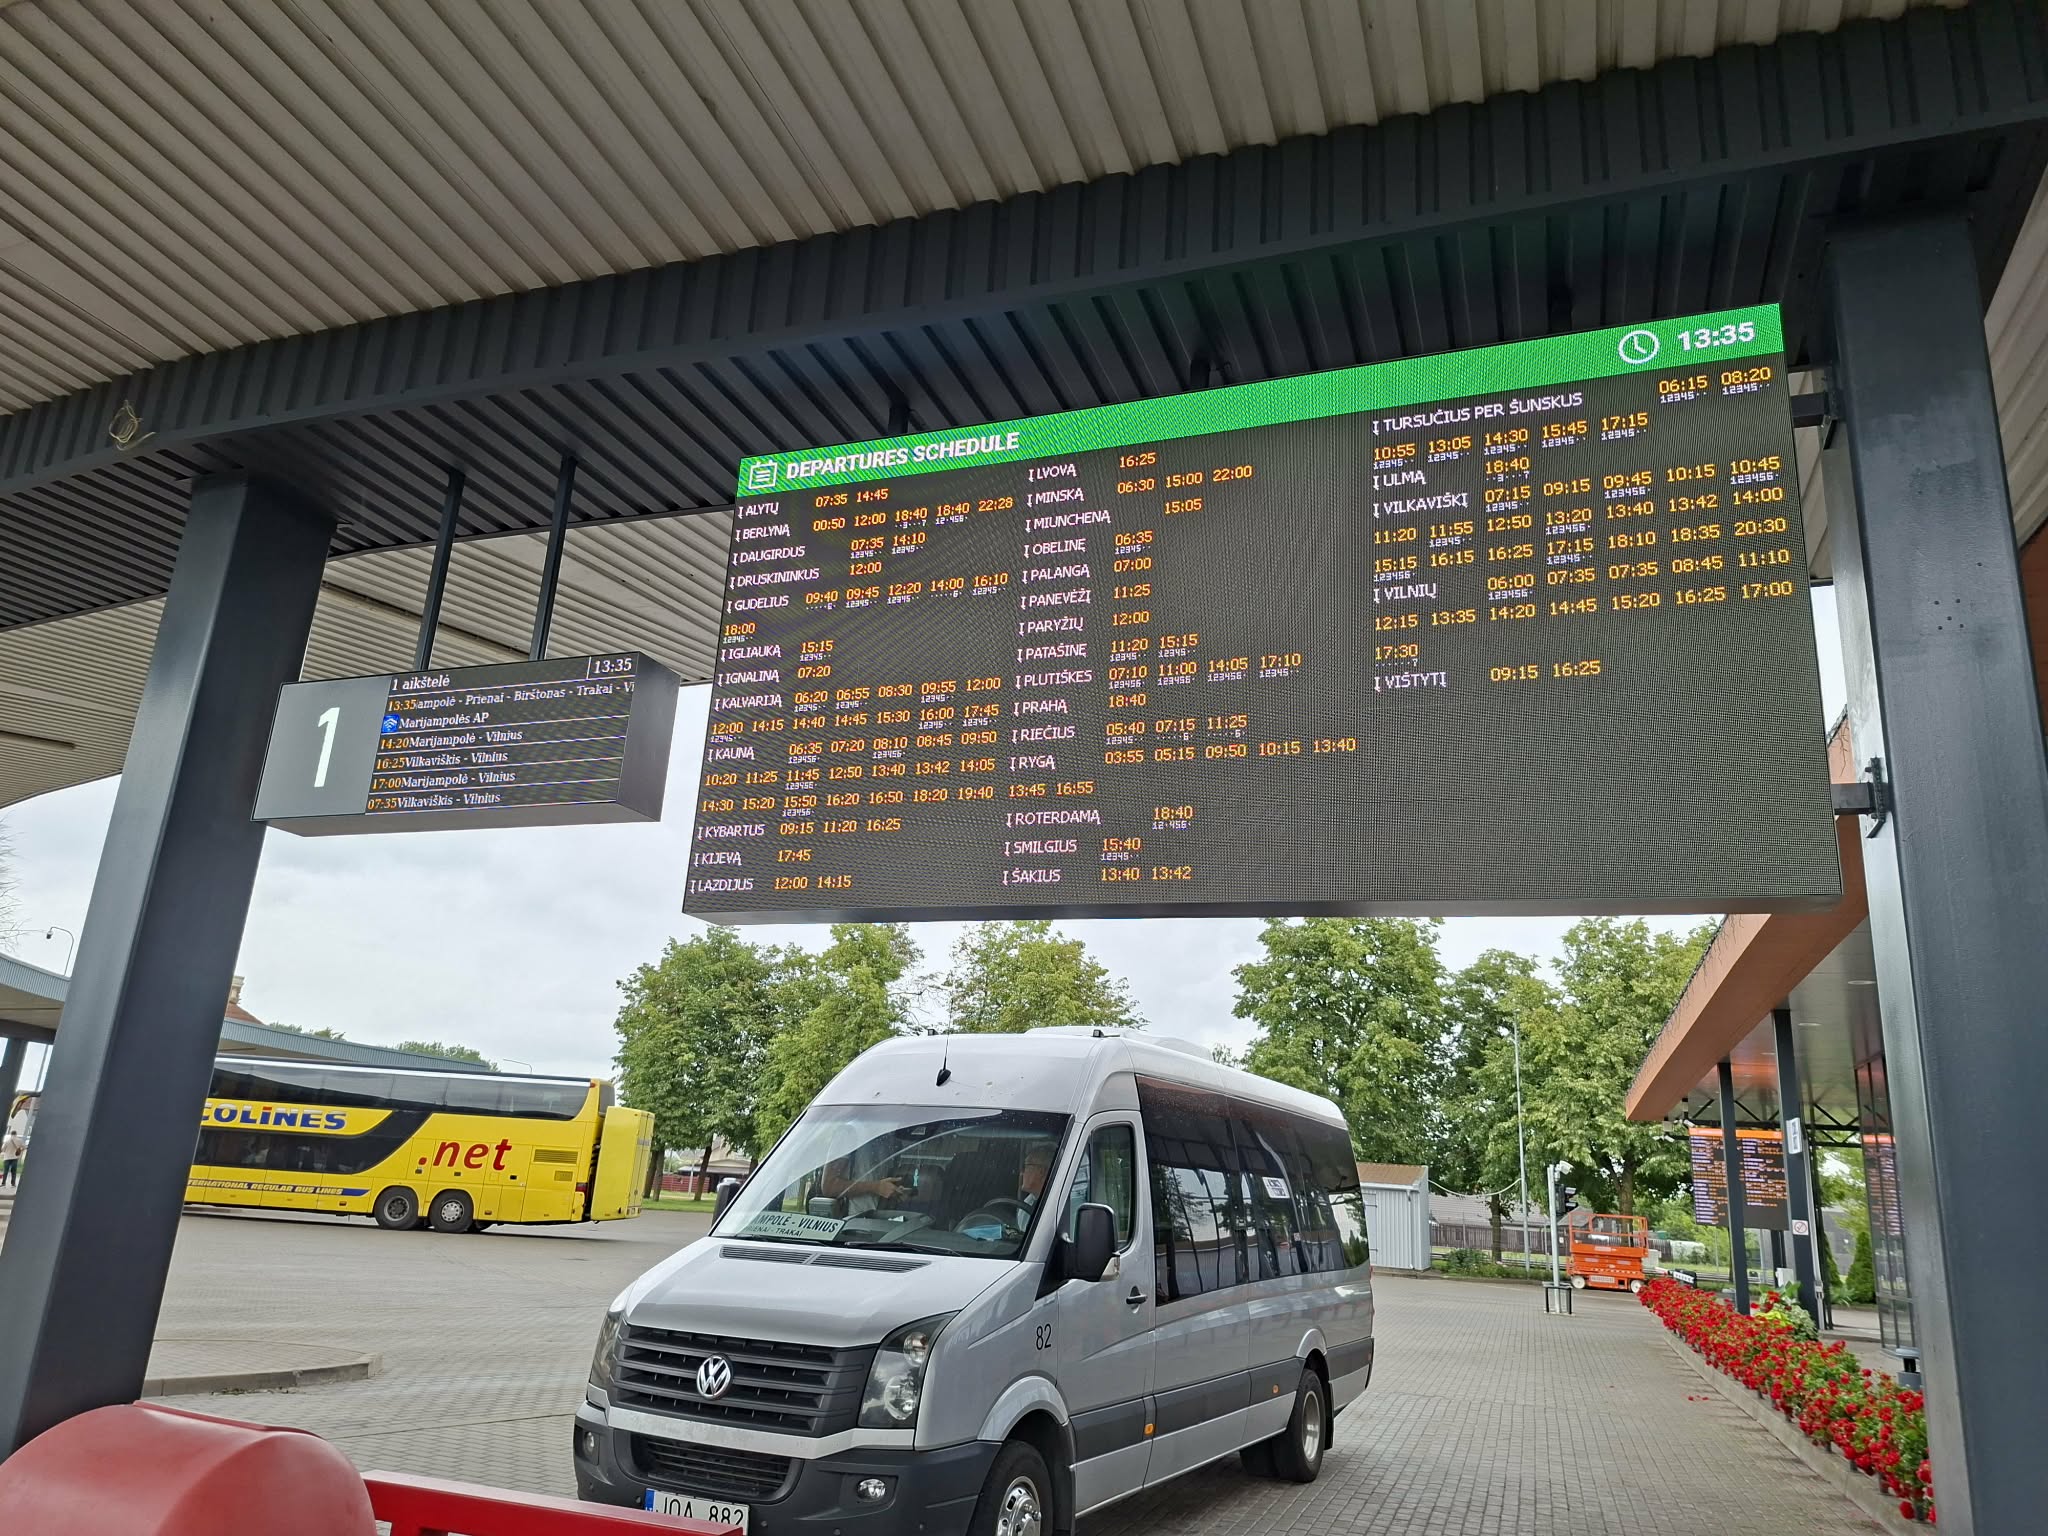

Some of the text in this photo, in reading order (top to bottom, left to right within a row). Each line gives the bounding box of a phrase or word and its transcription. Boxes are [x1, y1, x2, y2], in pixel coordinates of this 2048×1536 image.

[1677, 322, 1755, 351] 13:35
[1383, 407, 1470, 432] TURSUČIUS
[1474, 403, 1505, 419] PER
[1509, 392, 1582, 414] ŠUNSKUS
[1659, 375, 1707, 393] 06:15
[1721, 366, 1771, 385] 08:20
[786, 432, 1020, 480] DEPARTURES SCHEDULE
[1374, 435, 1471, 460] 10:55 13:05
[1036, 452, 1156, 479] LVOVĄ 16:25
[1383, 470, 1427, 486] ULMĄ
[1485, 456, 1529, 474] 18:40
[1035, 471, 1202, 504] MINSKĄ 06:30 15:00
[1383, 491, 1468, 515] VILKAVIŠKĮ
[1485, 485, 1531, 503] 07:15
[1543, 478, 1591, 496] 09:15
[745, 488, 888, 516] ALYTŲ 07:35 14:45
[1033, 497, 1202, 529] MIUNCHENĄ 15:05
[742, 507, 927, 539] BERLYNĄ 00:50 12:00 18:40
[1375, 520, 1473, 544] 11:20 11:55
[739, 531, 925, 563] DAUGIRDUS 07:35 14:10
[1032, 530, 1152, 555] OBELINĘ 06:35
[1030, 557, 1151, 581] PALANGĄ 07:00
[1375, 549, 1474, 572] 15:15 16:15
[736, 561, 882, 587] DRUSKININKUS 12:00
[1384, 582, 1436, 600] VILNIŲ
[1487, 573, 1534, 590] 06:00
[1547, 567, 1595, 585] 07:35
[734, 581, 922, 611] GUDELIUS 09:40 09:45 12:20
[1113, 583, 1150, 599] 11:25
[1112, 610, 1149, 625] 12:00
[1375, 608, 1476, 630] 12:15 13:35
[724, 622, 755, 636] 18:00
[728, 639, 834, 659] IGLIAUKĄ 15:15
[1111, 638, 1148, 653] 11:20
[1159, 633, 1198, 648] 15:15
[1375, 643, 1418, 660] 17:30
[594, 658, 632, 674] 13:35
[724, 665, 831, 684] IGNALINĄ 07:20
[1024, 661, 1197, 687] PLUTIŠKES 07:10 11:00
[1490, 664, 1538, 681] 09:15
[1553, 659, 1600, 677] 16:25
[402, 674, 450, 690] aikštelė
[388, 699, 417, 712] 13:35
[465, 692, 504, 705] Prienai
[514, 689, 566, 701] Birštonas
[576, 684, 613, 696] Trakai
[721, 687, 870, 709] KALVARIJĄ 06:20 06:55
[1022, 693, 1146, 716] PRAHĄ 18:40
[398, 712, 490, 729] Marijampolės AP
[712, 718, 784, 734] 12:00 14:15
[1106, 721, 1145, 736] 05:40
[1155, 718, 1196, 733] 07:15
[314, 707, 340, 788] 1
[380, 731, 523, 750] 14:20 Marijampolė Vilnius
[715, 738, 865, 760] KAUNĄ 06:35 07:20
[376, 752, 508, 770] 16:25 Vilkaviškis Vilnius
[1018, 746, 1196, 770] RYGĄ 03:55 05:15
[372, 771, 516, 790] 17:00 Marijampolė Vilnius
[704, 770, 777, 786] 10:20 11:25
[1008, 780, 1094, 797] 13:45 16:55
[367, 792, 501, 810] 07:35 Vilkaviškis Vilnius
[702, 797, 775, 812] 14:30 15:20
[1015, 805, 1193, 825] ROTERDAMĄ 18:40
[704, 820, 857, 838] KYBARTUS 09:15 11:20
[701, 848, 811, 866] KIJEVĄ 17:45
[1013, 838, 1141, 854] SMILGIUS 15:40
[697, 875, 851, 892] LAZDIJUS 12:00 14:15
[1011, 865, 1192, 887] ŠAKIUS 13:40 13:42
[418, 1138, 512, 1171] .net
[250, 1182, 293, 1192] REGULAR
[315, 1187, 343, 1195] LINES
[775, 1227, 803, 1237] TRAKAI
[798, 1217, 839, 1233] VILNIUS
[1036, 1323, 1052, 1350] 82
